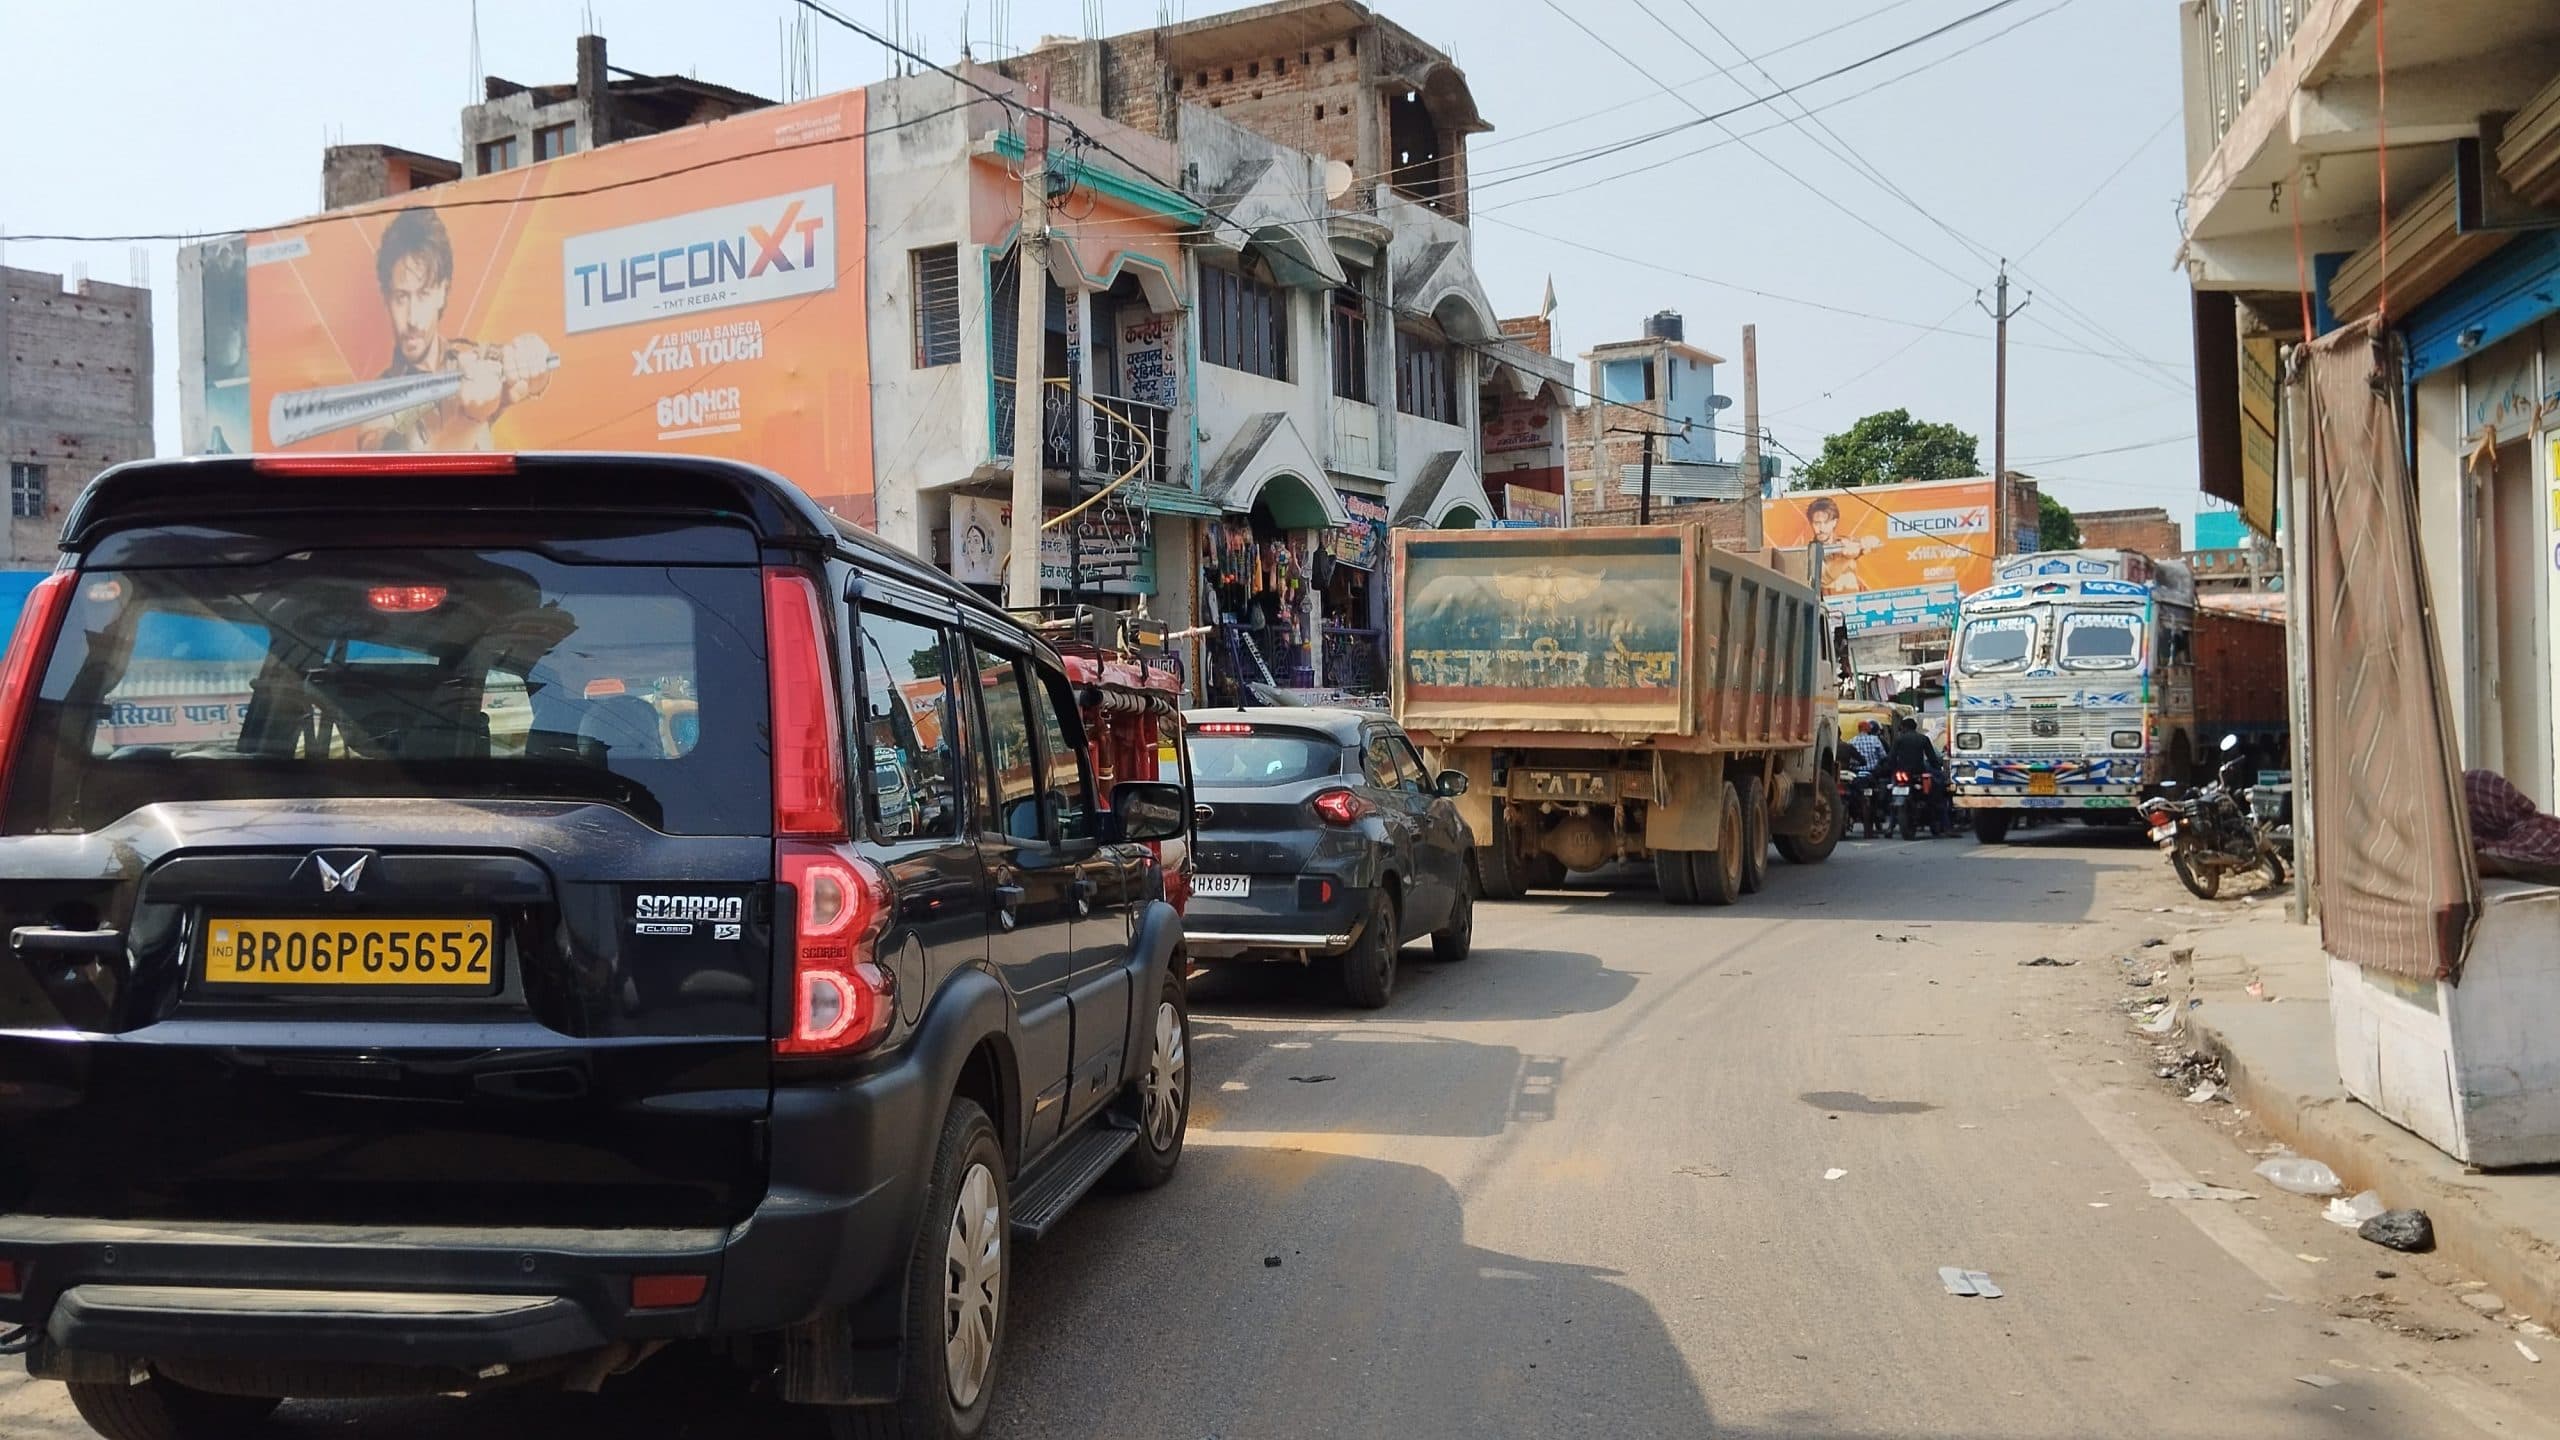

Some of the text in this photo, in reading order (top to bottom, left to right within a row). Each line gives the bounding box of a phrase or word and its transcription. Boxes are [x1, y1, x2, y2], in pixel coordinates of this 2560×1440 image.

[574, 200, 824, 307] TUFCONXT
[663, 291, 726, 310] TMT REBAR
[663, 319, 762, 346] AB INDIA BANEGA
[631, 334, 763, 377] XTRA TOUGH
[1891, 510, 1985, 533] TUFCONXT
[1530, 771, 1605, 796] TATA
[635, 894, 743, 922] SCORPIO
[646, 925, 689, 934] CLASSIC
[212, 931, 489, 974] IND BR06PG5652
[802, 947, 847, 959] SCORPIO
